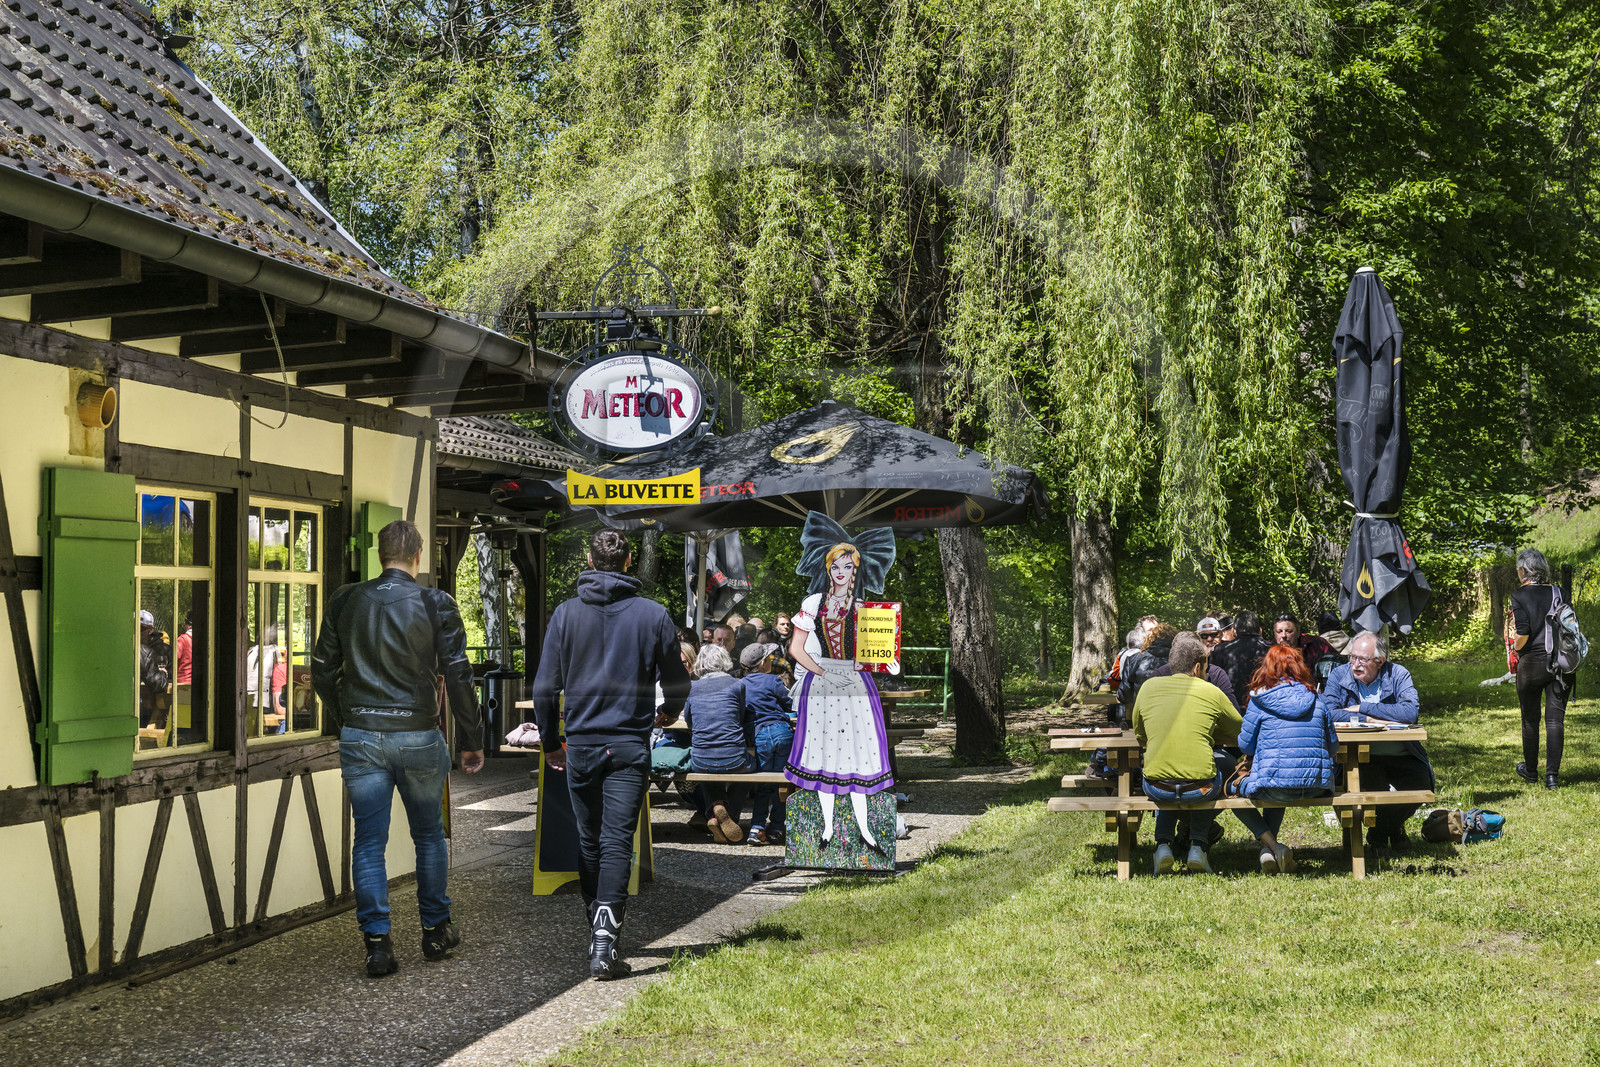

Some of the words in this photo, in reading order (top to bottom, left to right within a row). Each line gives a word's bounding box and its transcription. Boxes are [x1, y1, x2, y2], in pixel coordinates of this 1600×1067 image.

[625, 375, 638, 388] M
[580, 387, 687, 419] METEOR
[573, 484, 600, 499] LA
[604, 483, 695, 499] BUVETTE
[700, 481, 756, 498] ETEOR
[860, 648, 892, 659] 11H30
